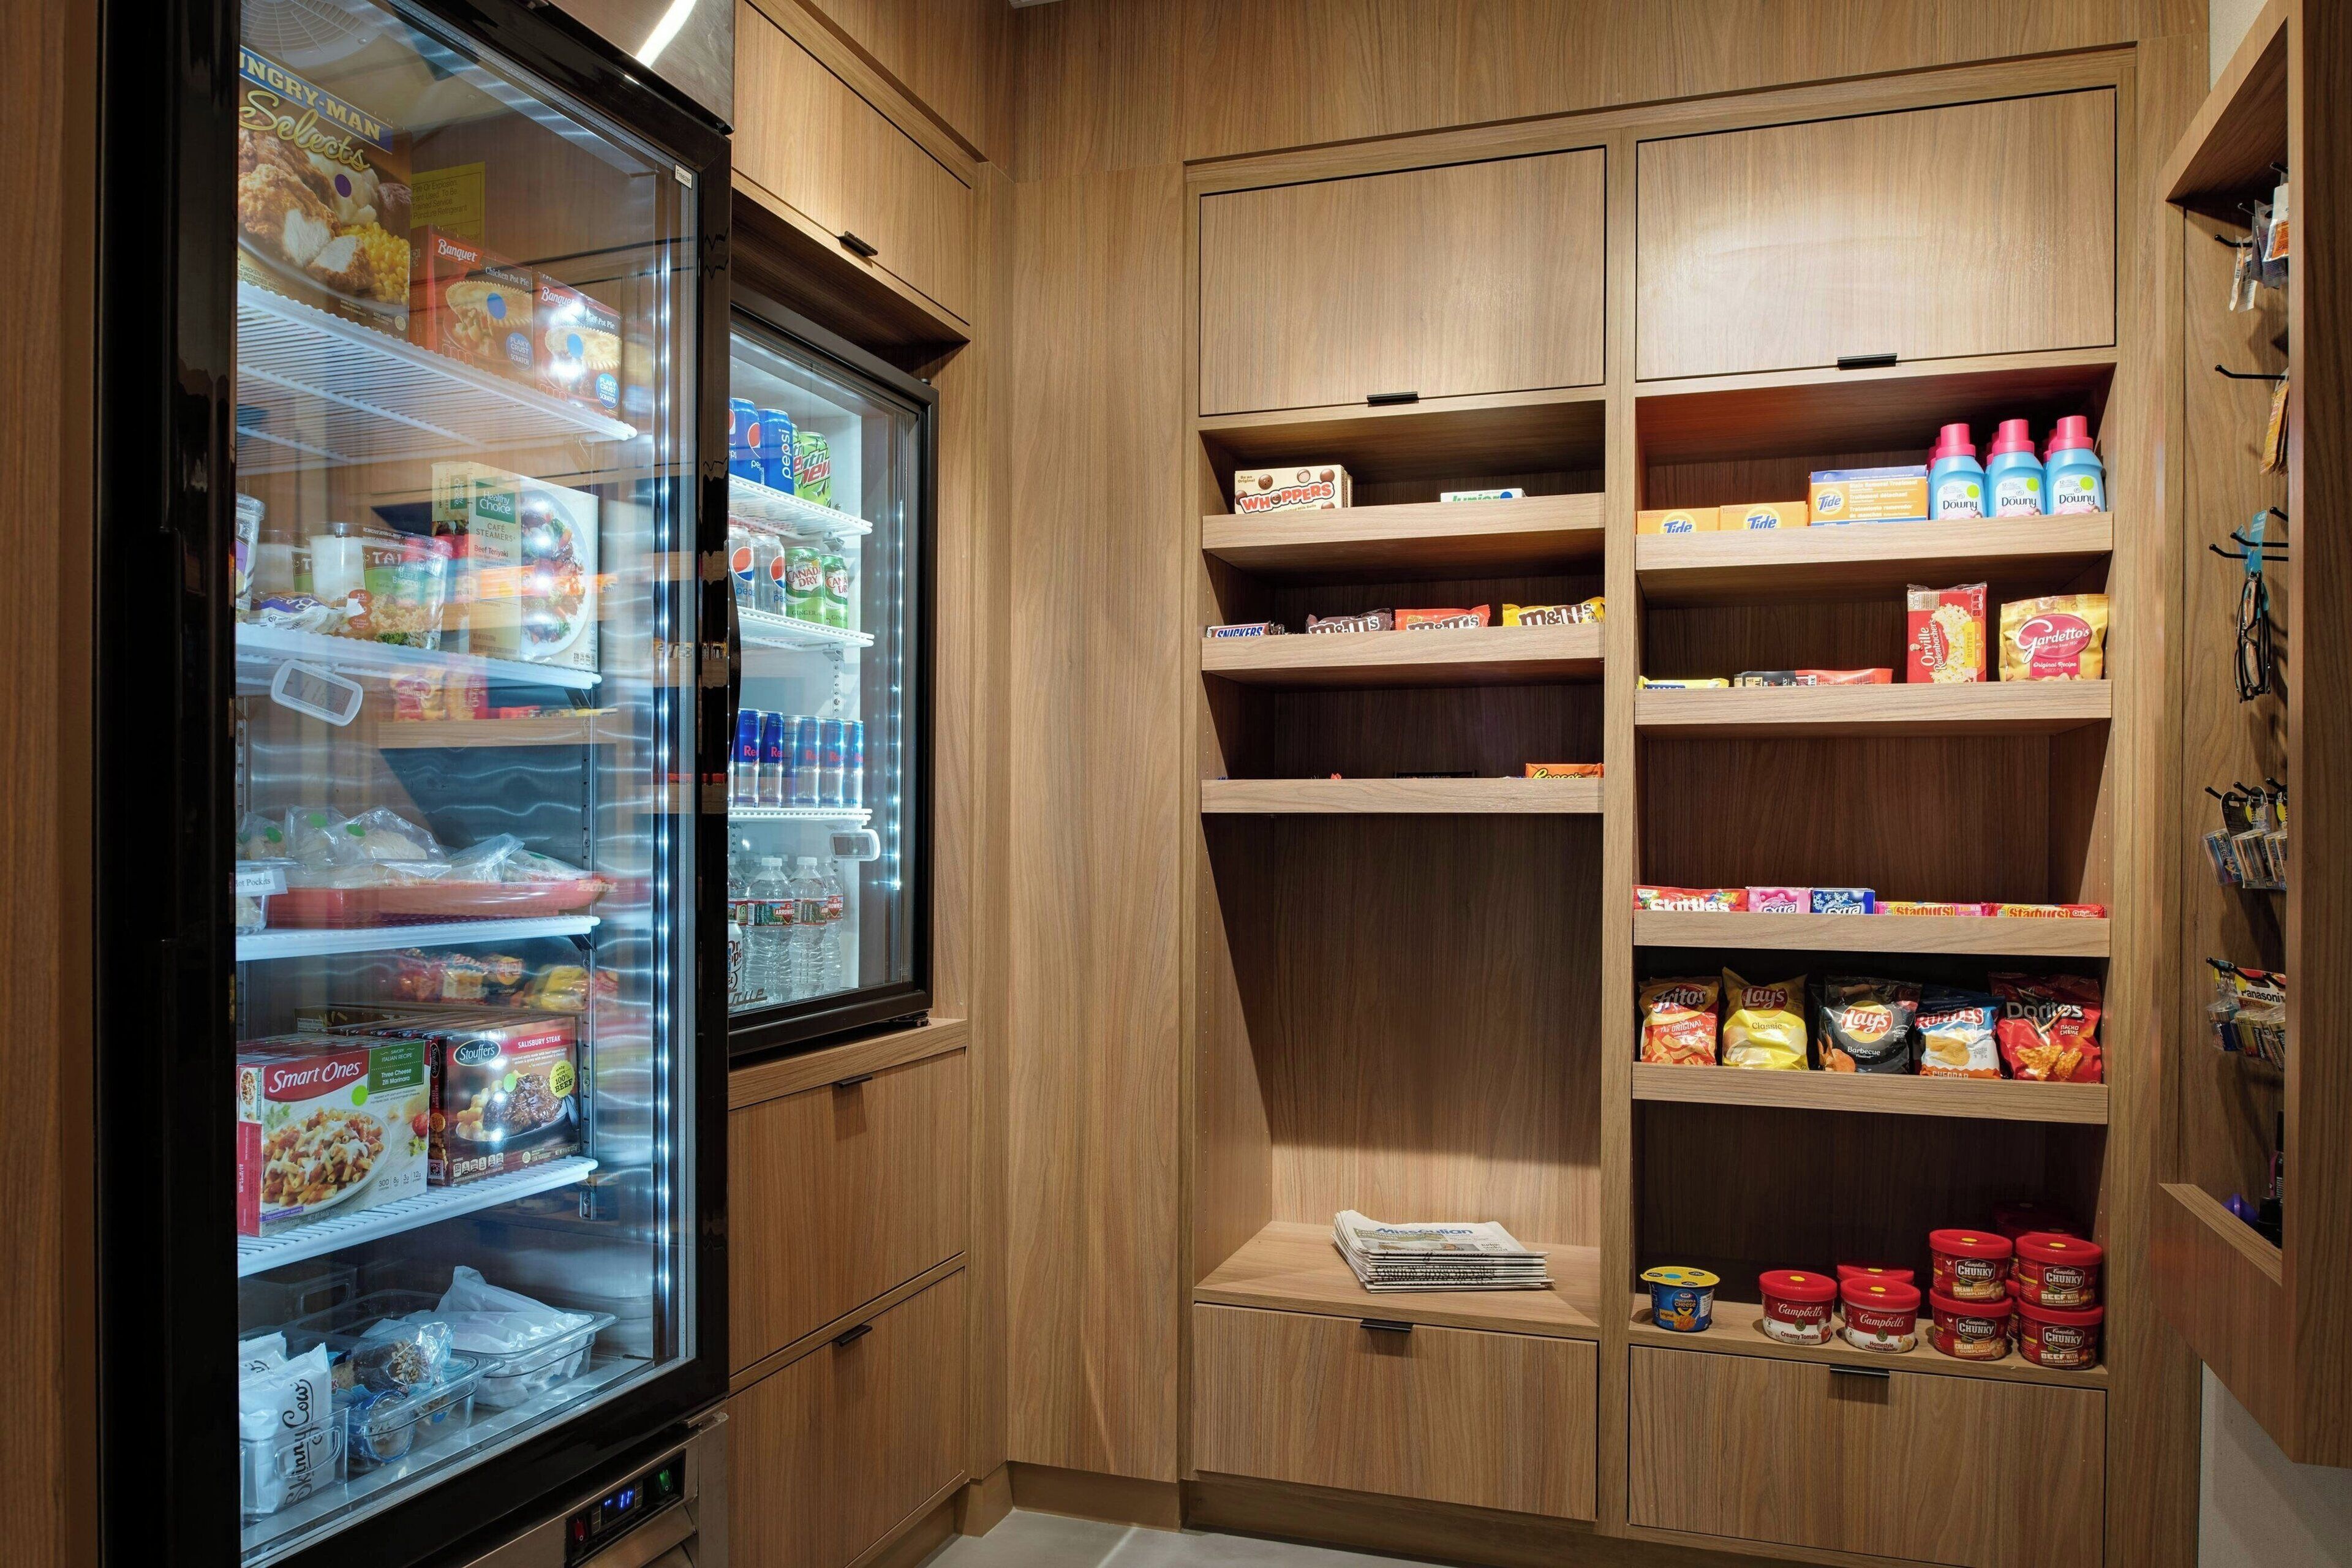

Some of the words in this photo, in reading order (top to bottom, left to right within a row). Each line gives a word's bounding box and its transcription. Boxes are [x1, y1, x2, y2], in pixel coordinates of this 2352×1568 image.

[239, 90, 370, 171] Selects
[676, 168, 691, 184] Freezer
[438, 239, 478, 263] Banquet
[485, 266, 508, 281] Chicken
[510, 274, 519, 284] Pot
[520, 277, 529, 287] Pie
[598, 317, 606, 326] Pot
[510, 337, 529, 348] FLAKY
[511, 343, 529, 354] CRUST
[510, 353, 529, 366] SCRATCH
[778, 428, 793, 480] pepsi
[483, 490, 510, 505] Healthy
[1241, 483, 1332, 511] WHOPPERS
[1818, 494, 1841, 511] Tide
[2002, 496, 2037, 508] Downy
[2059, 494, 2095, 506] Downy
[480, 497, 511, 514] Choice
[1943, 499, 1978, 511] Downy
[487, 522, 505, 533] CAFÉ
[1664, 521, 1692, 533] Tide
[1747, 515, 1777, 529] Tide
[476, 528, 514, 543] STEAMERS
[474, 545, 487, 553] Beef
[488, 547, 508, 558] Teriyaki
[786, 565, 822, 583] CANADA
[799, 576, 818, 587] DRY
[792, 608, 816, 616] GINGER
[1216, 626, 1263, 638] SNICKERS
[1918, 627, 1936, 666] Orville
[1929, 618, 1947, 673] Redenbacher's
[2016, 619, 2090, 664] Gardetto's
[1649, 897, 1730, 912] Skittles
[1896, 905, 1955, 916] Starburst
[2008, 907, 2070, 918] Starburst
[1652, 986, 1707, 1014] Fritos
[1746, 987, 1785, 1009] Lay's
[1915, 1007, 1983, 1028] RUFFLES
[2005, 1001, 2083, 1020] Doritos
[1672, 1019, 1703, 1033] ORIGINAL
[1752, 1022, 1782, 1030] Classic
[1842, 1008, 1890, 1034] Lay's
[518, 1038, 545, 1049] SALISBURY
[546, 1035, 561, 1044] STEAK
[2253, 1028, 2265, 1059] Panasonic
[459, 1044, 495, 1061] Stouffer's
[1847, 1046, 1881, 1056] Barbecue
[269, 1067, 319, 1093] Smart
[322, 1060, 361, 1083] Ones
[555, 1073, 570, 1085] 100%
[555, 1078, 573, 1093] BEEF
[1958, 1265, 1994, 1278] CHUNKY
[2046, 1272, 2082, 1284] CHUNKY
[1777, 1302, 1823, 1318] Campbell's
[1859, 1313, 1905, 1329] Campbell's
[1959, 1322, 1994, 1335] CHUNKY
[1781, 1331, 1800, 1340] Creamy
[2045, 1332, 2082, 1345] CHUNKY
[282, 1379, 314, 1428] Cow
[284, 1421, 323, 1505] Skinny
